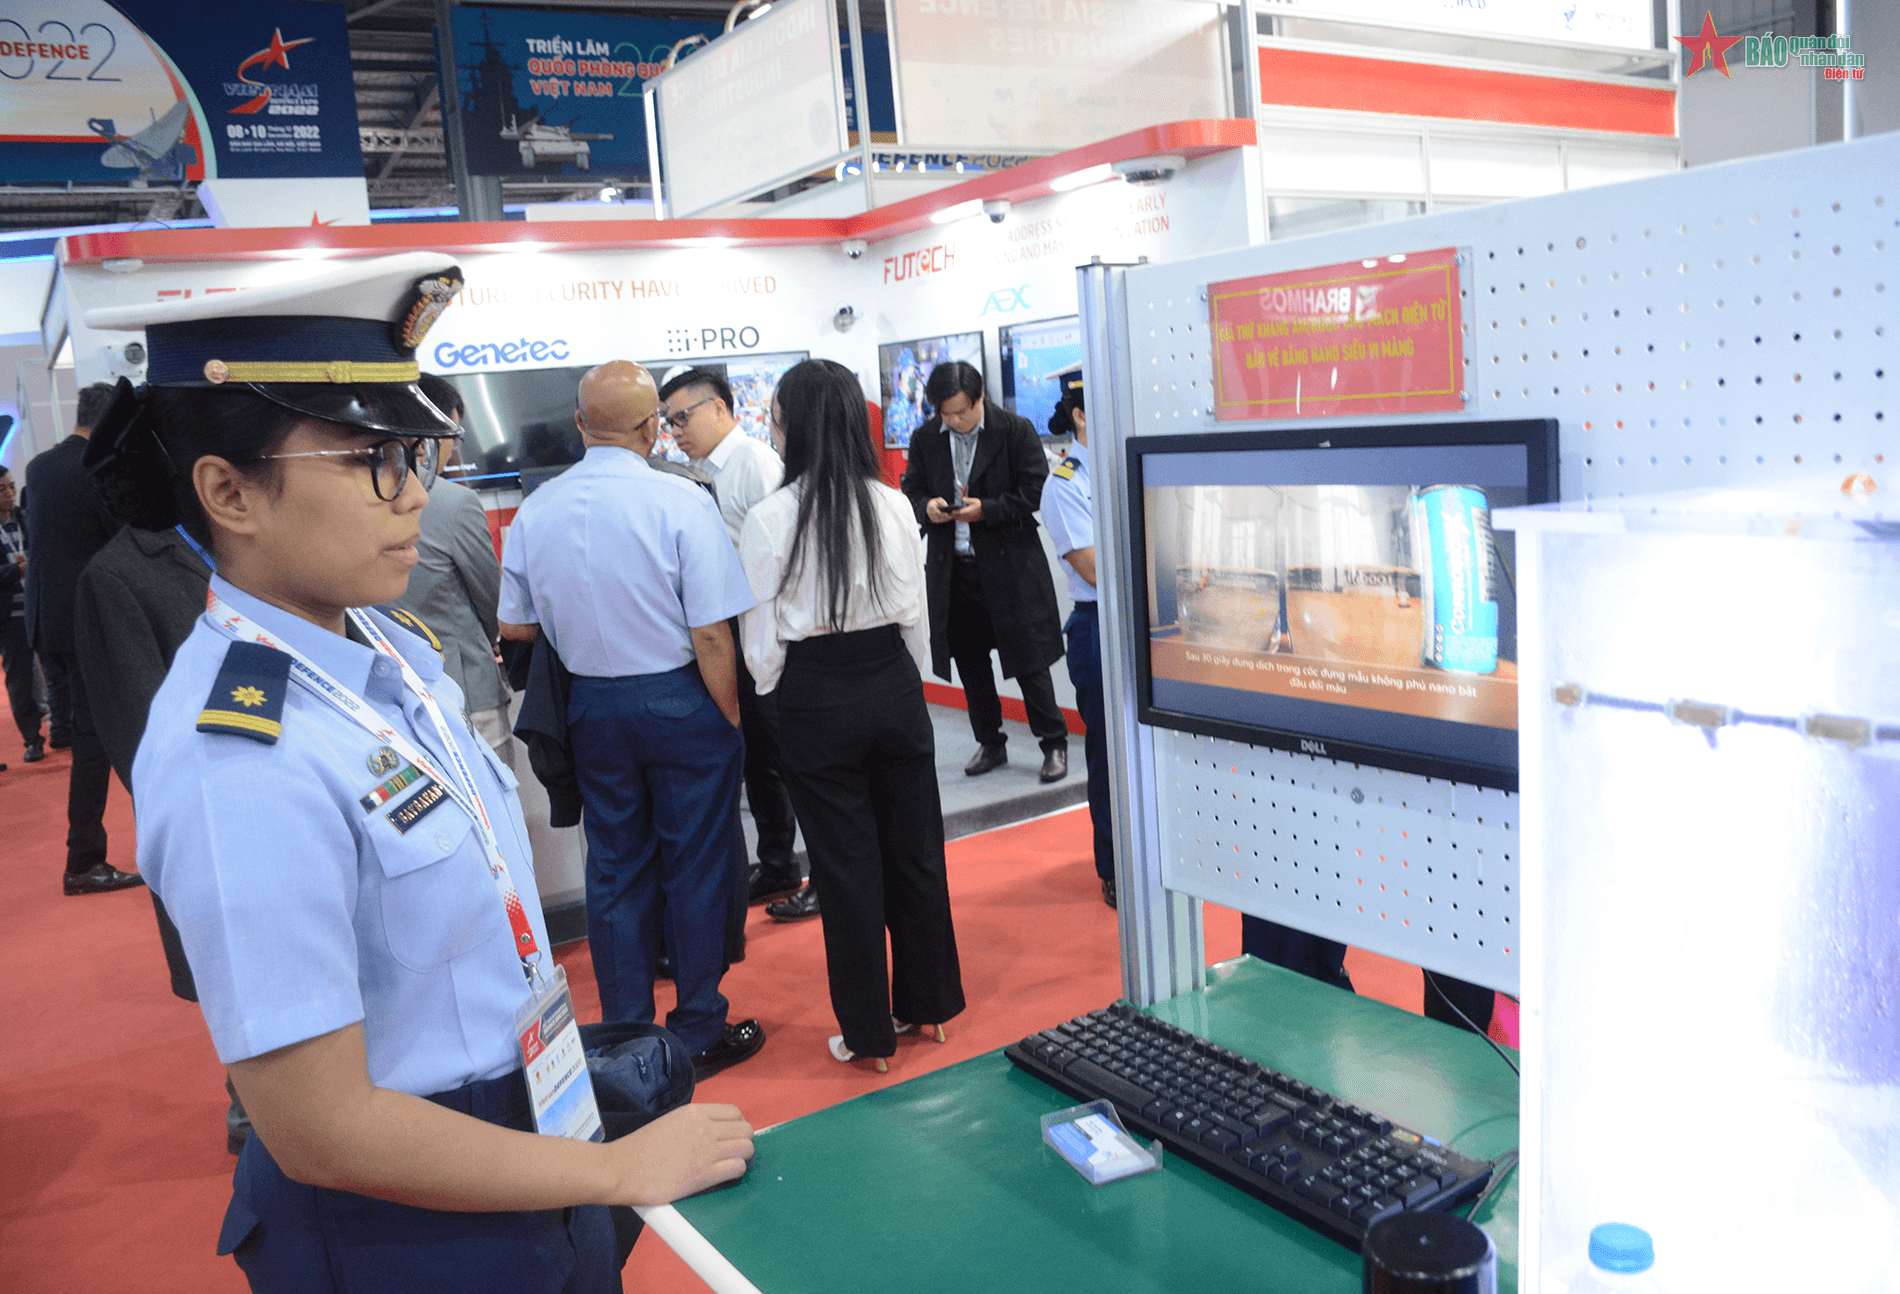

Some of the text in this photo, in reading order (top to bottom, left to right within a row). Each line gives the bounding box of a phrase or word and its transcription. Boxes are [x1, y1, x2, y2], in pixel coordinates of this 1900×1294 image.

[0, 41, 90, 60] DEFENCE
[525, 35, 609, 56] TRIỂN LÃM
[528, 53, 576, 76] QUỐC
[578, 57, 635, 77] PHÒNG
[530, 77, 613, 98] VIỆT NAM
[293, 125, 320, 139] 2022
[1007, 219, 1053, 243] ADDRESS
[1020, 243, 1042, 261] AND
[434, 337, 570, 369] Genetec
[1311, 345, 1340, 364] NANO
[1368, 342, 1380, 360] VI
[1185, 651, 1200, 662] Sau
[1202, 652, 1212, 663] 30
[1213, 655, 1231, 668] giây
[1232, 657, 1254, 671] dung
[1256, 659, 1275, 672] dịch
[1276, 662, 1301, 676] trong
[1302, 665, 1319, 677] cốc
[1371, 673, 1404, 691] không
[1405, 678, 1427, 691] phủ
[1428, 682, 1456, 695] nano
[1458, 684, 1478, 698] bắt
[1325, 682, 1347, 694] màu
[1300, 739, 1328, 756] DELL
[397, 784, 443, 825] BAYBAYAN
